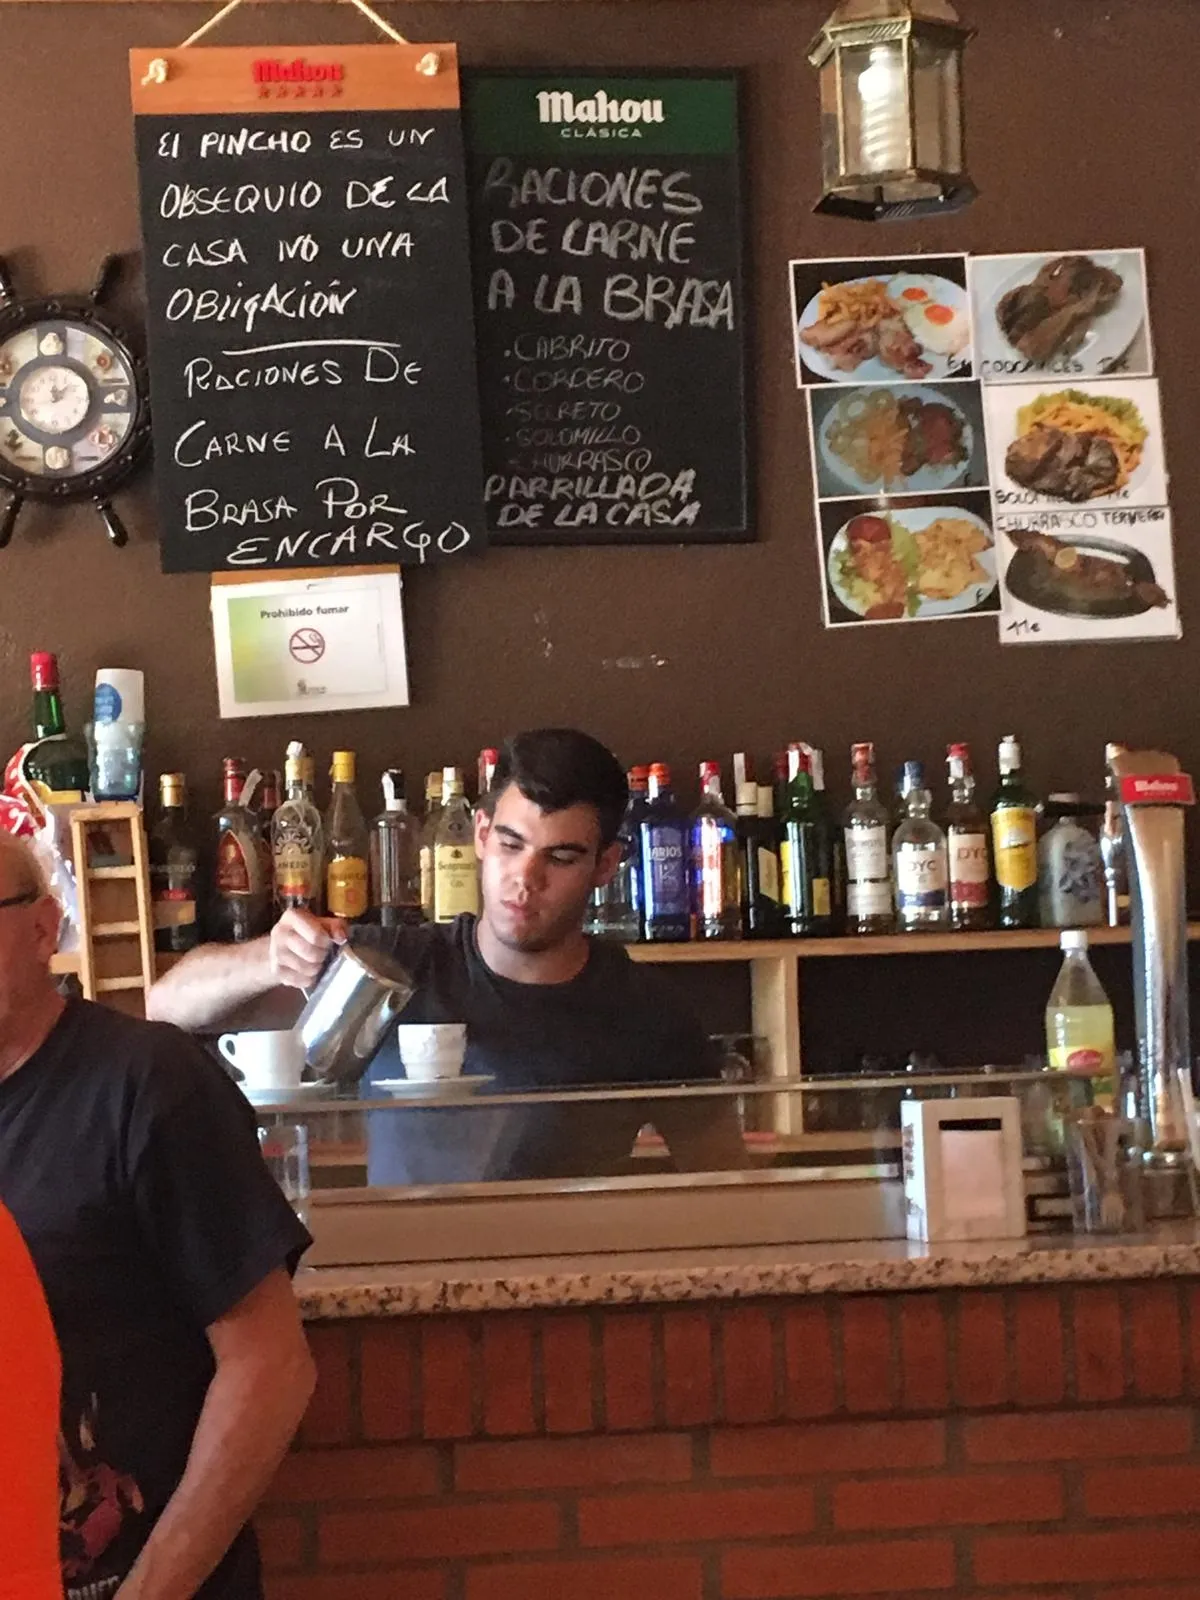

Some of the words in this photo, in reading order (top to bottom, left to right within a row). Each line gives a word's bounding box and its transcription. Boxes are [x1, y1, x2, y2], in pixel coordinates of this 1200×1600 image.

[536, 90, 665, 124] Mahou
[200, 128, 312, 158] PINCHO
[329, 129, 364, 149] ES
[388, 127, 435, 146] UN
[160, 180, 322, 219] OBSEQUIO
[346, 176, 396, 209] DE
[407, 176, 452, 203] LA
[484, 156, 703, 214] RACIONES
[162, 238, 248, 267] CASA
[278, 234, 319, 262] NO
[342, 231, 415, 259] UNA
[491, 218, 549, 255] DE
[561, 217, 696, 264] CARNE
[487, 268, 516, 311] A
[534, 274, 582, 316] LA
[603, 273, 734, 330] BRASA
[514, 334, 630, 362] CABRITO
[184, 357, 343, 398] RACIONES
[364, 346, 422, 385] DE
[514, 368, 645, 393] CORDERO
[174, 420, 290, 467] CARNE
[324, 424, 346, 456] A
[365, 415, 417, 458] LA
[517, 448, 652, 473] HURRASCO
[484, 468, 696, 502] PARRILLADA
[185, 488, 298, 532] BRASA
[315, 477, 408, 519] POR
[497, 503, 544, 527] DE
[554, 502, 598, 526] LA
[605, 500, 701, 526] CASA
[226, 521, 470, 565] ENCARGO
[260, 608, 313, 619] Prohibido
[316, 605, 350, 615] fumar
[651, 846, 683, 858] ARIOS
